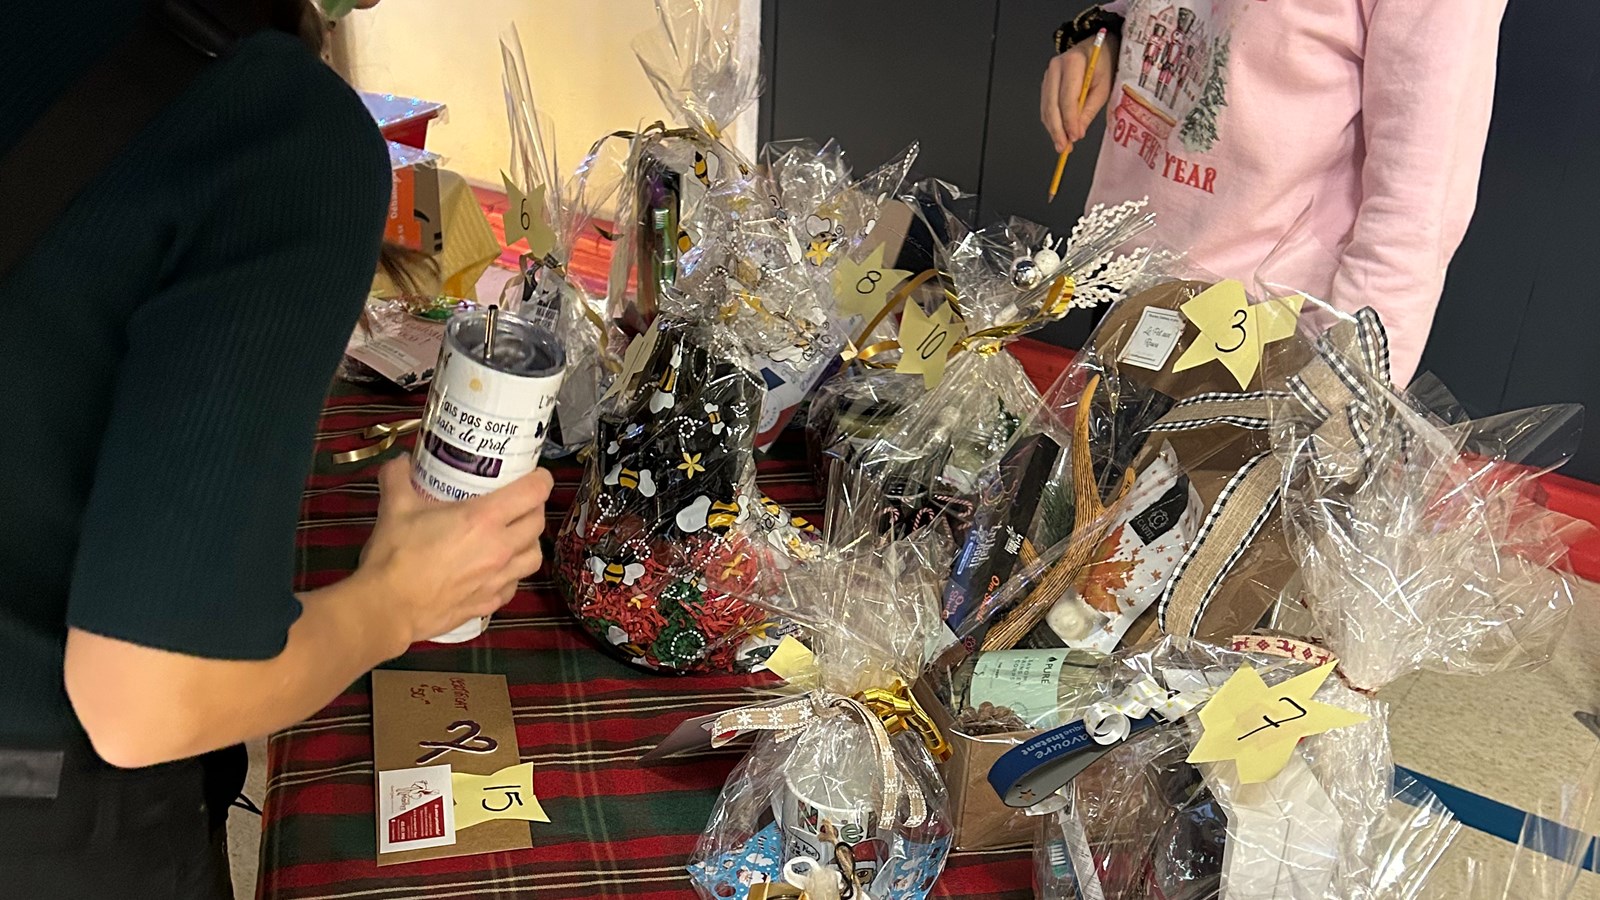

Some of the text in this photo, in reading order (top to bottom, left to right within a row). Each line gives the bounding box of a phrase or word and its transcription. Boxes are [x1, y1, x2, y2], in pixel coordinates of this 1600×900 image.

[1114, 118, 1217, 194] OF THE YEAR
[520, 198, 531, 231] 6
[856, 270, 882, 295] 8
[916, 323, 948, 360] 10
[1215, 309, 1248, 353] 3
[460, 411, 482, 428] pas
[485, 420, 519, 436] sortir
[459, 428, 476, 443] de
[476, 437, 511, 455] prof
[1237, 697, 1307, 741] 7
[1035, 733, 1088, 758] avoure
[482, 785, 523, 812] 15
